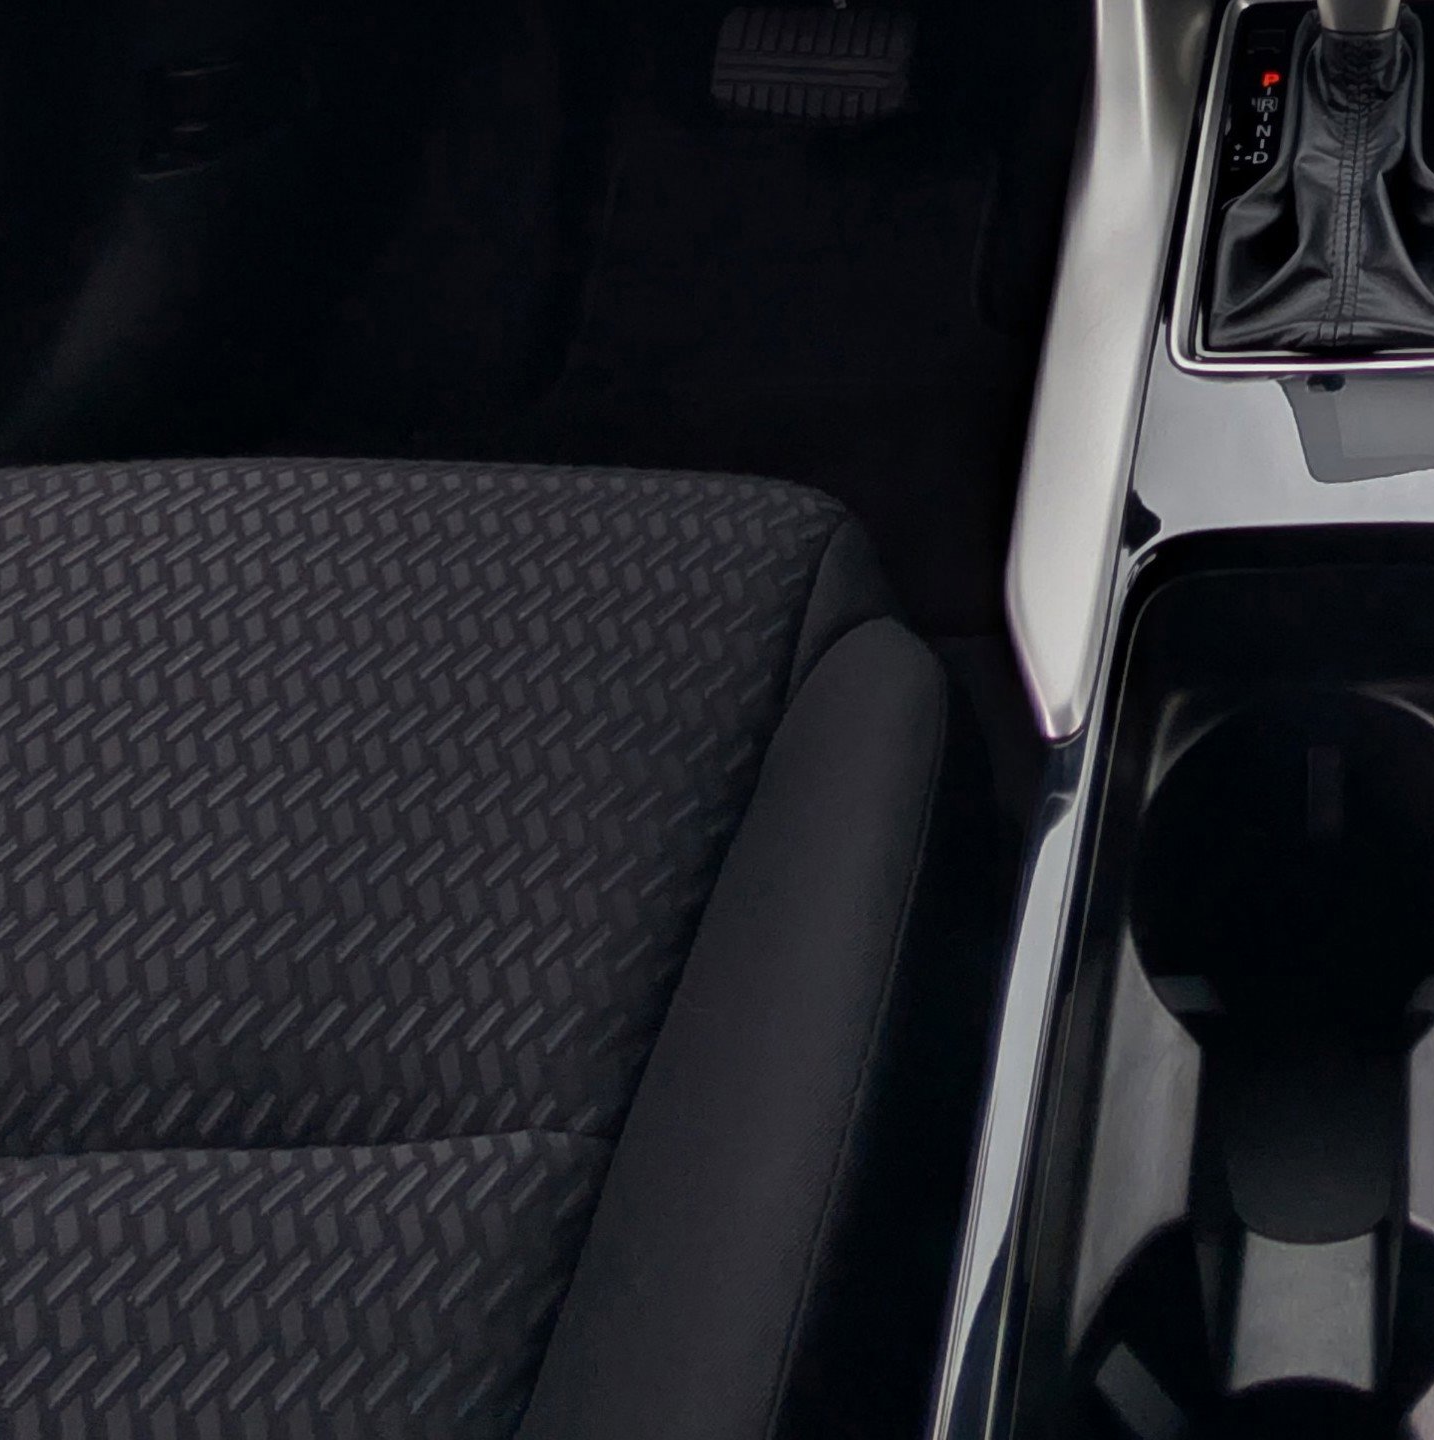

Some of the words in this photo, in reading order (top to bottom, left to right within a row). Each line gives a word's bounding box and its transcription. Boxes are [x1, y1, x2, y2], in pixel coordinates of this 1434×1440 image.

[1263, 73, 1280, 87] P
[1256, 124, 1272, 138] N
[1252, 151, 1268, 164] D
